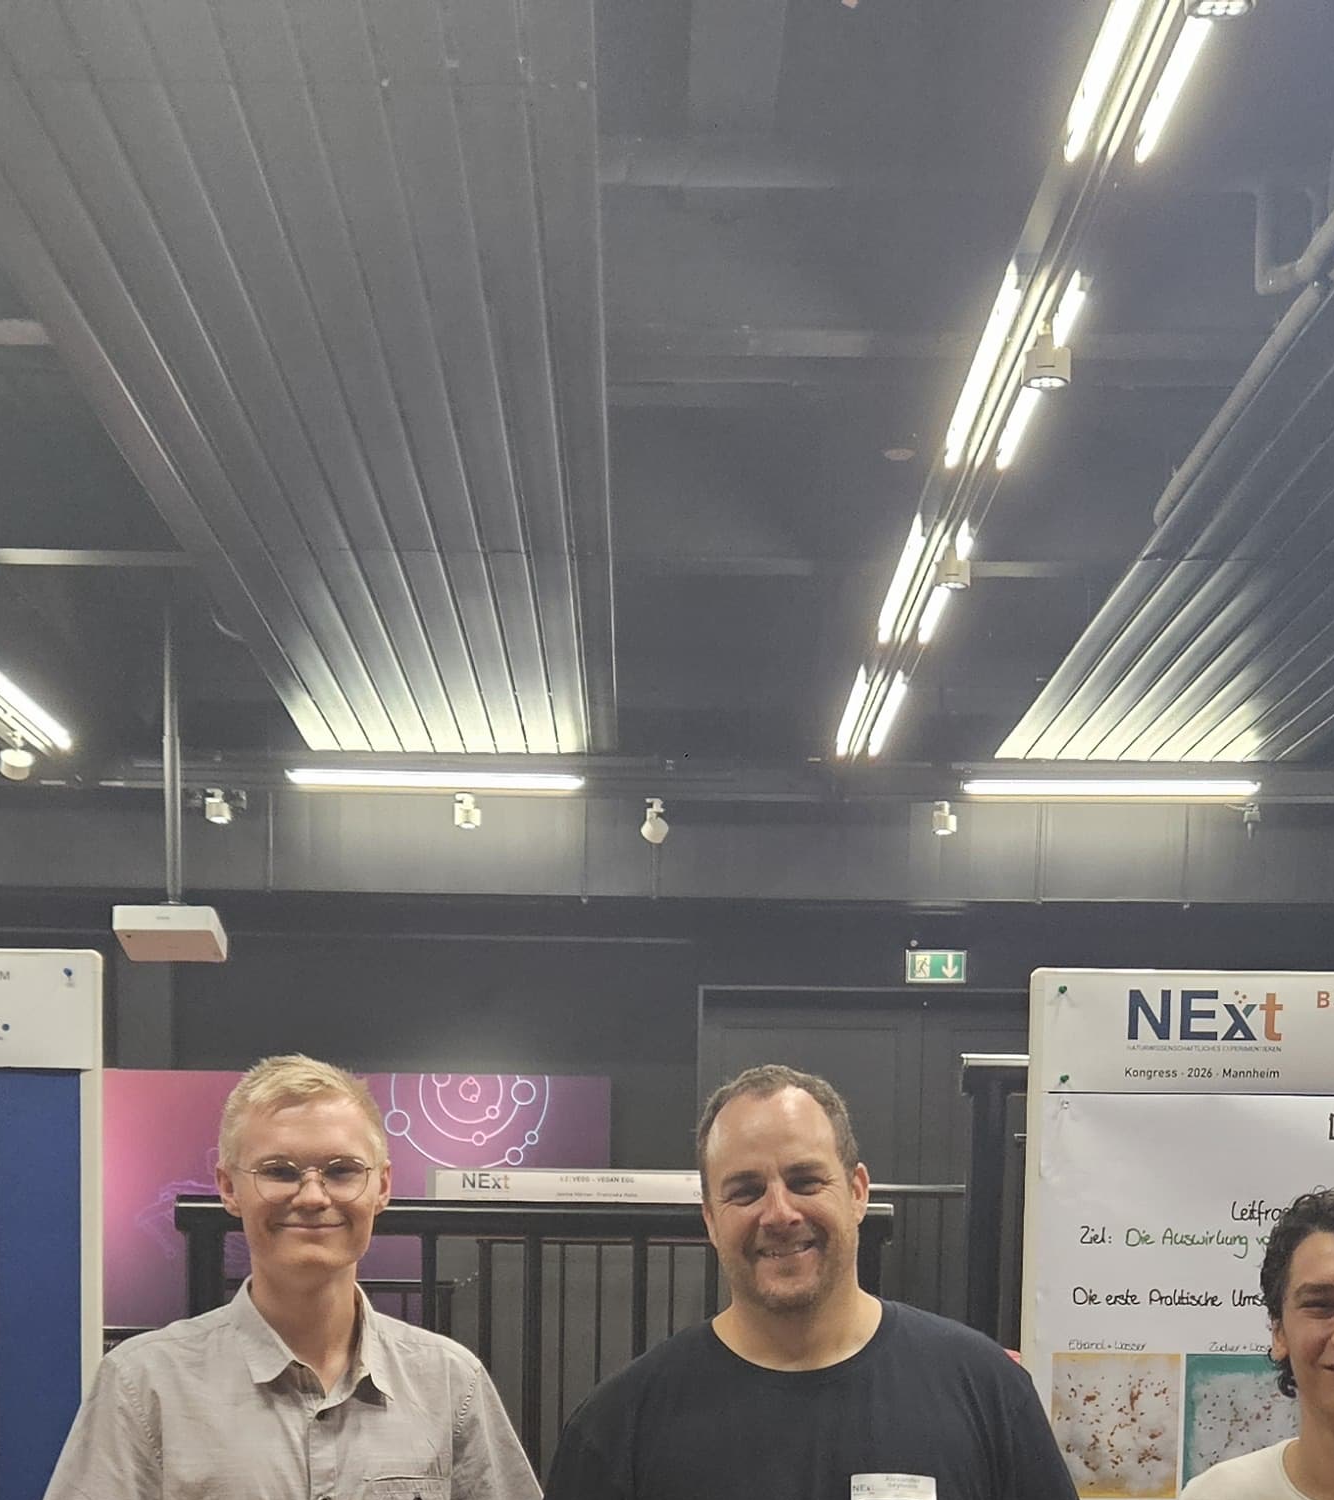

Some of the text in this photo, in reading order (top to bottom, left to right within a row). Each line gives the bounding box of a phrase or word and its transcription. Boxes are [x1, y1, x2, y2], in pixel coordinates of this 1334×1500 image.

[1127, 989, 1284, 1042] NExt
[1124, 1067, 1280, 1080] Kongress 2026 Mannheim
[462, 1173, 510, 1190] NExt
[1080, 1225, 1113, 1245] Ziel:
[1125, 1227, 1155, 1247] Die
[1162, 1227, 1249, 1259] Auswirkung
[1072, 1287, 1101, 1306] Die
[1105, 1289, 1141, 1306] erste
